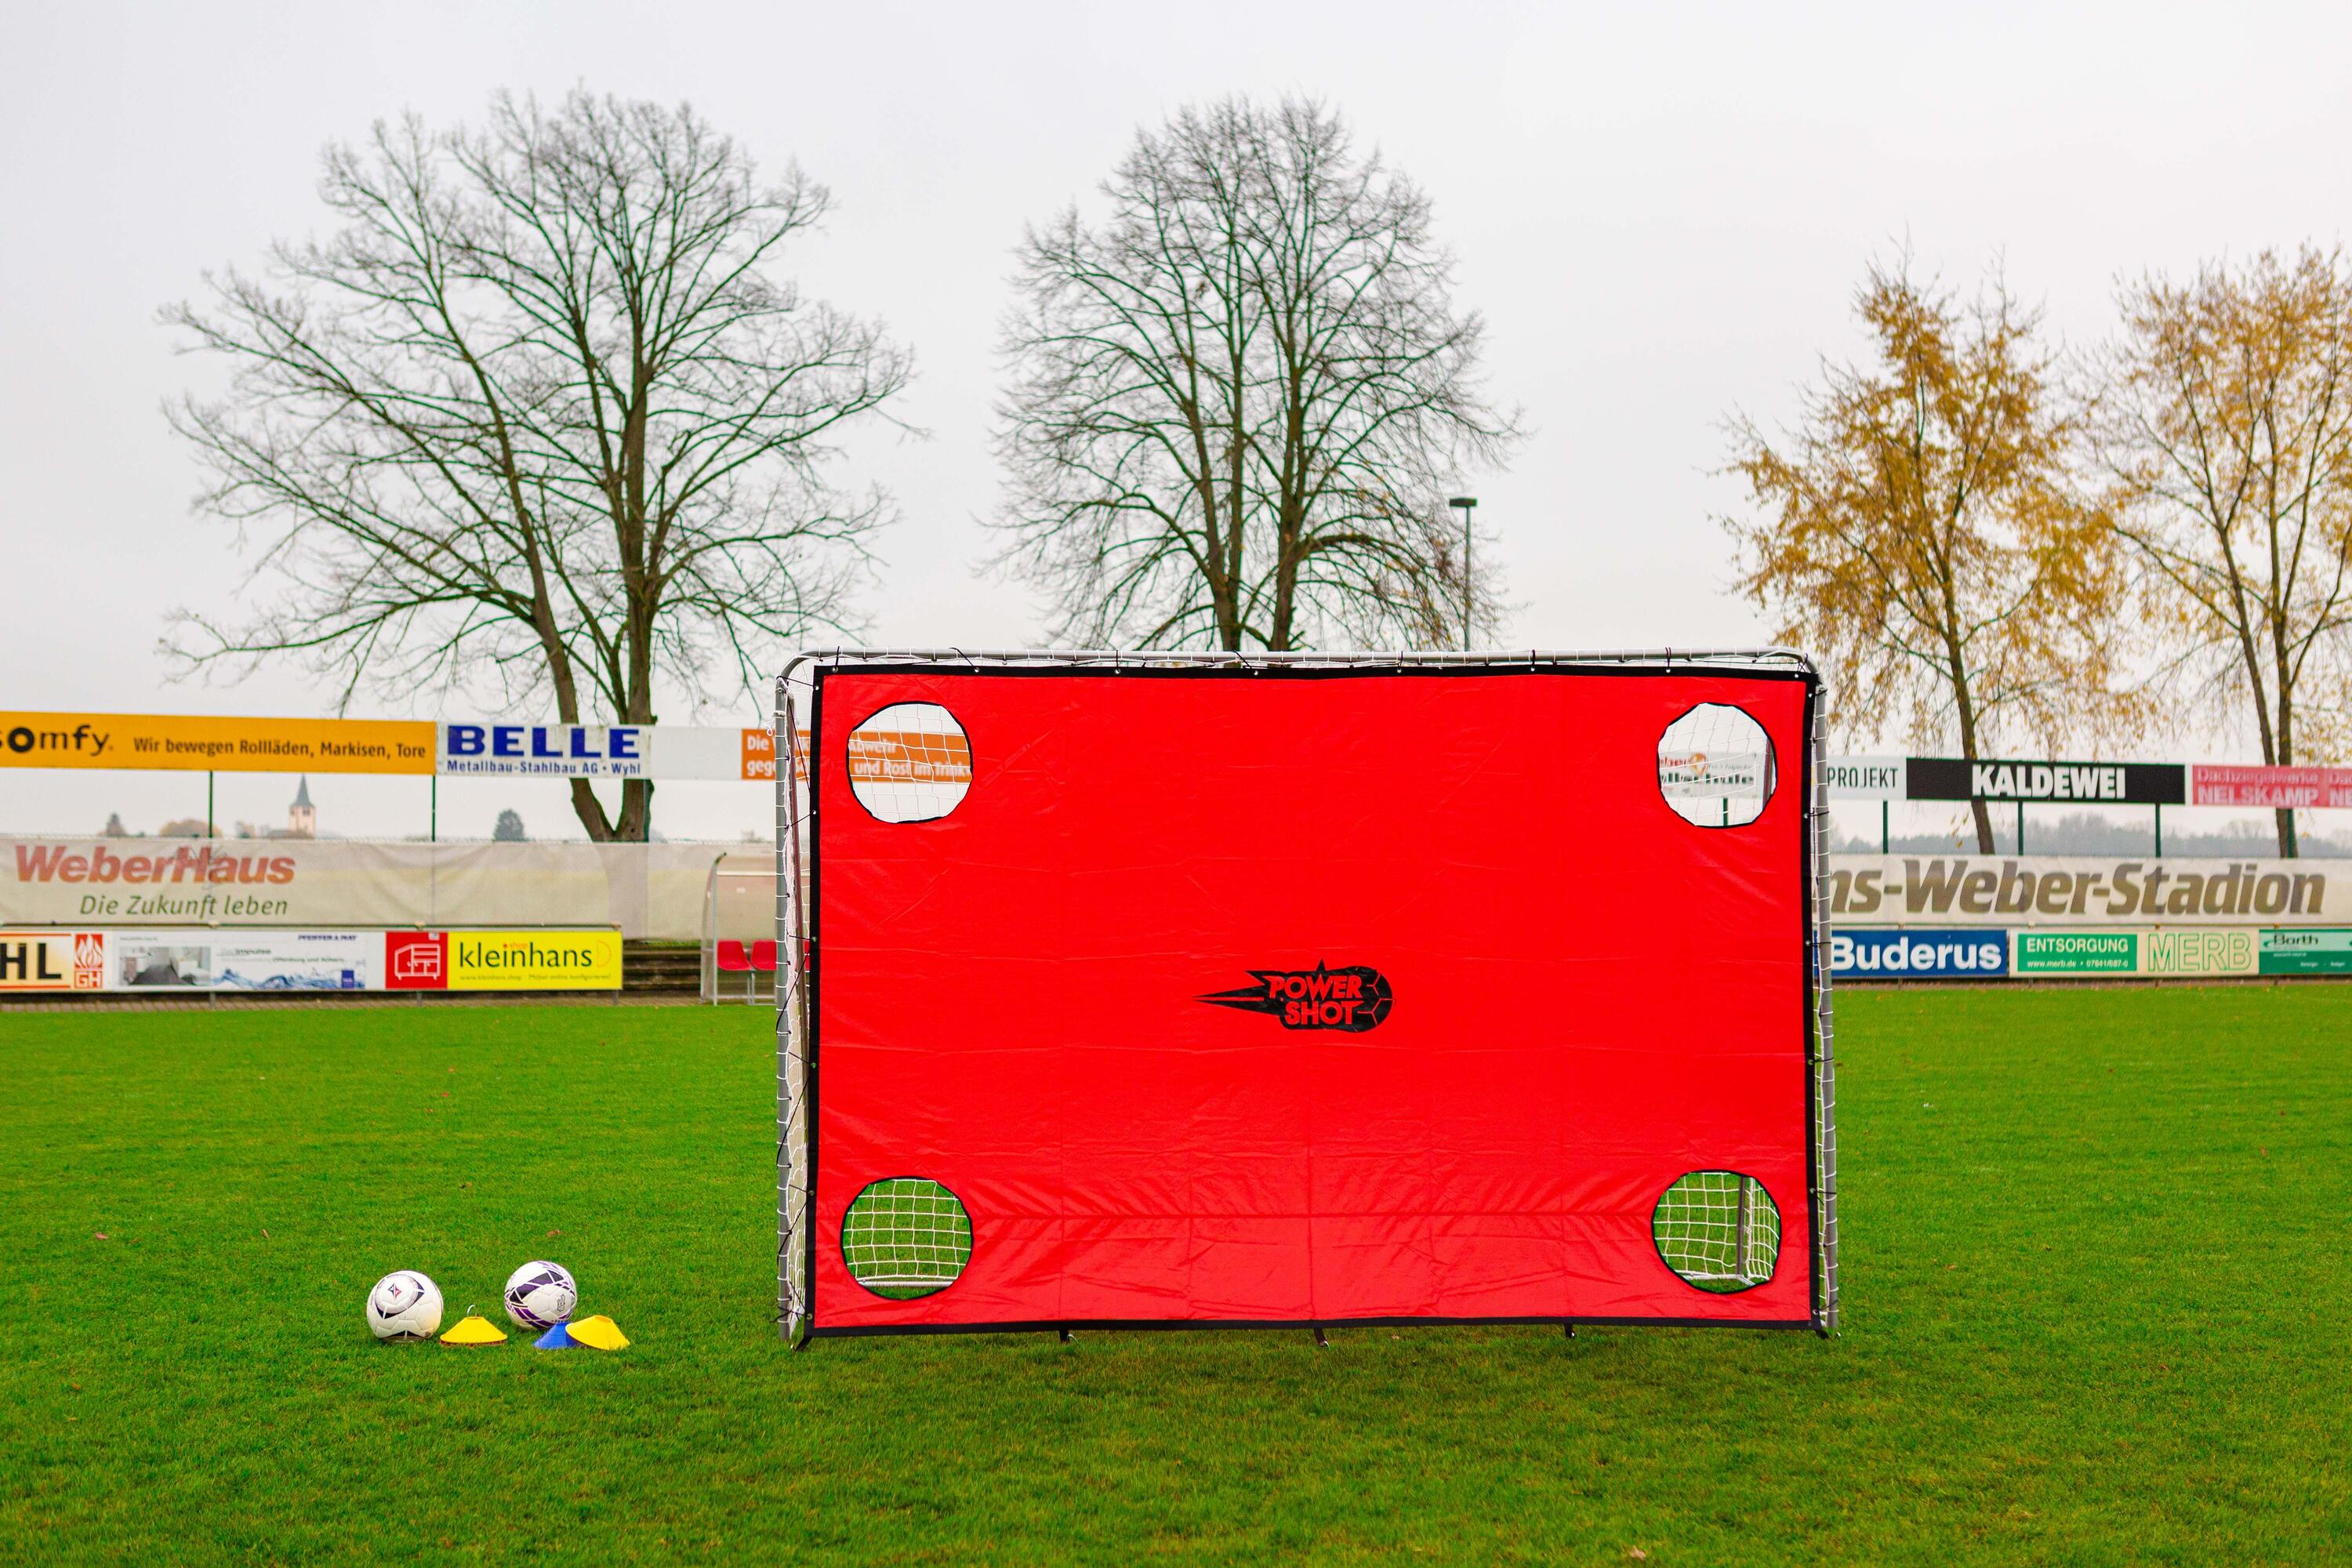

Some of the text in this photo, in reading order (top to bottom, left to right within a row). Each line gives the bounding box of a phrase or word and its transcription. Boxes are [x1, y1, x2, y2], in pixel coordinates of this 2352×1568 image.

[133, 738, 426, 760] Wir bewegen Rollläden, Markisen, Tore
[448, 725, 639, 758] BELLE
[747, 735, 769, 750] Die
[447, 760, 641, 776] Metallbau-Stahlbau AG Wyhl
[746, 760, 775, 776] geg
[1828, 767, 1898, 788] PROJEKT
[1972, 764, 2125, 799] KALDEWEI
[2198, 785, 2319, 805] NELSKAMP
[15, 845, 296, 884] WeberHaus
[1813, 859, 2326, 916] ns-Weber-Stadion
[80, 895, 288, 919] Die Zukunft leben
[459, 942, 592, 968] kleinhans
[1831, 936, 2002, 971] Buderus
[2027, 938, 2129, 953] ENTSORGUNG
[2147, 931, 2252, 972] MERB
[1262, 974, 1363, 1000] POWER
[1285, 1001, 1364, 1025] SHOT
